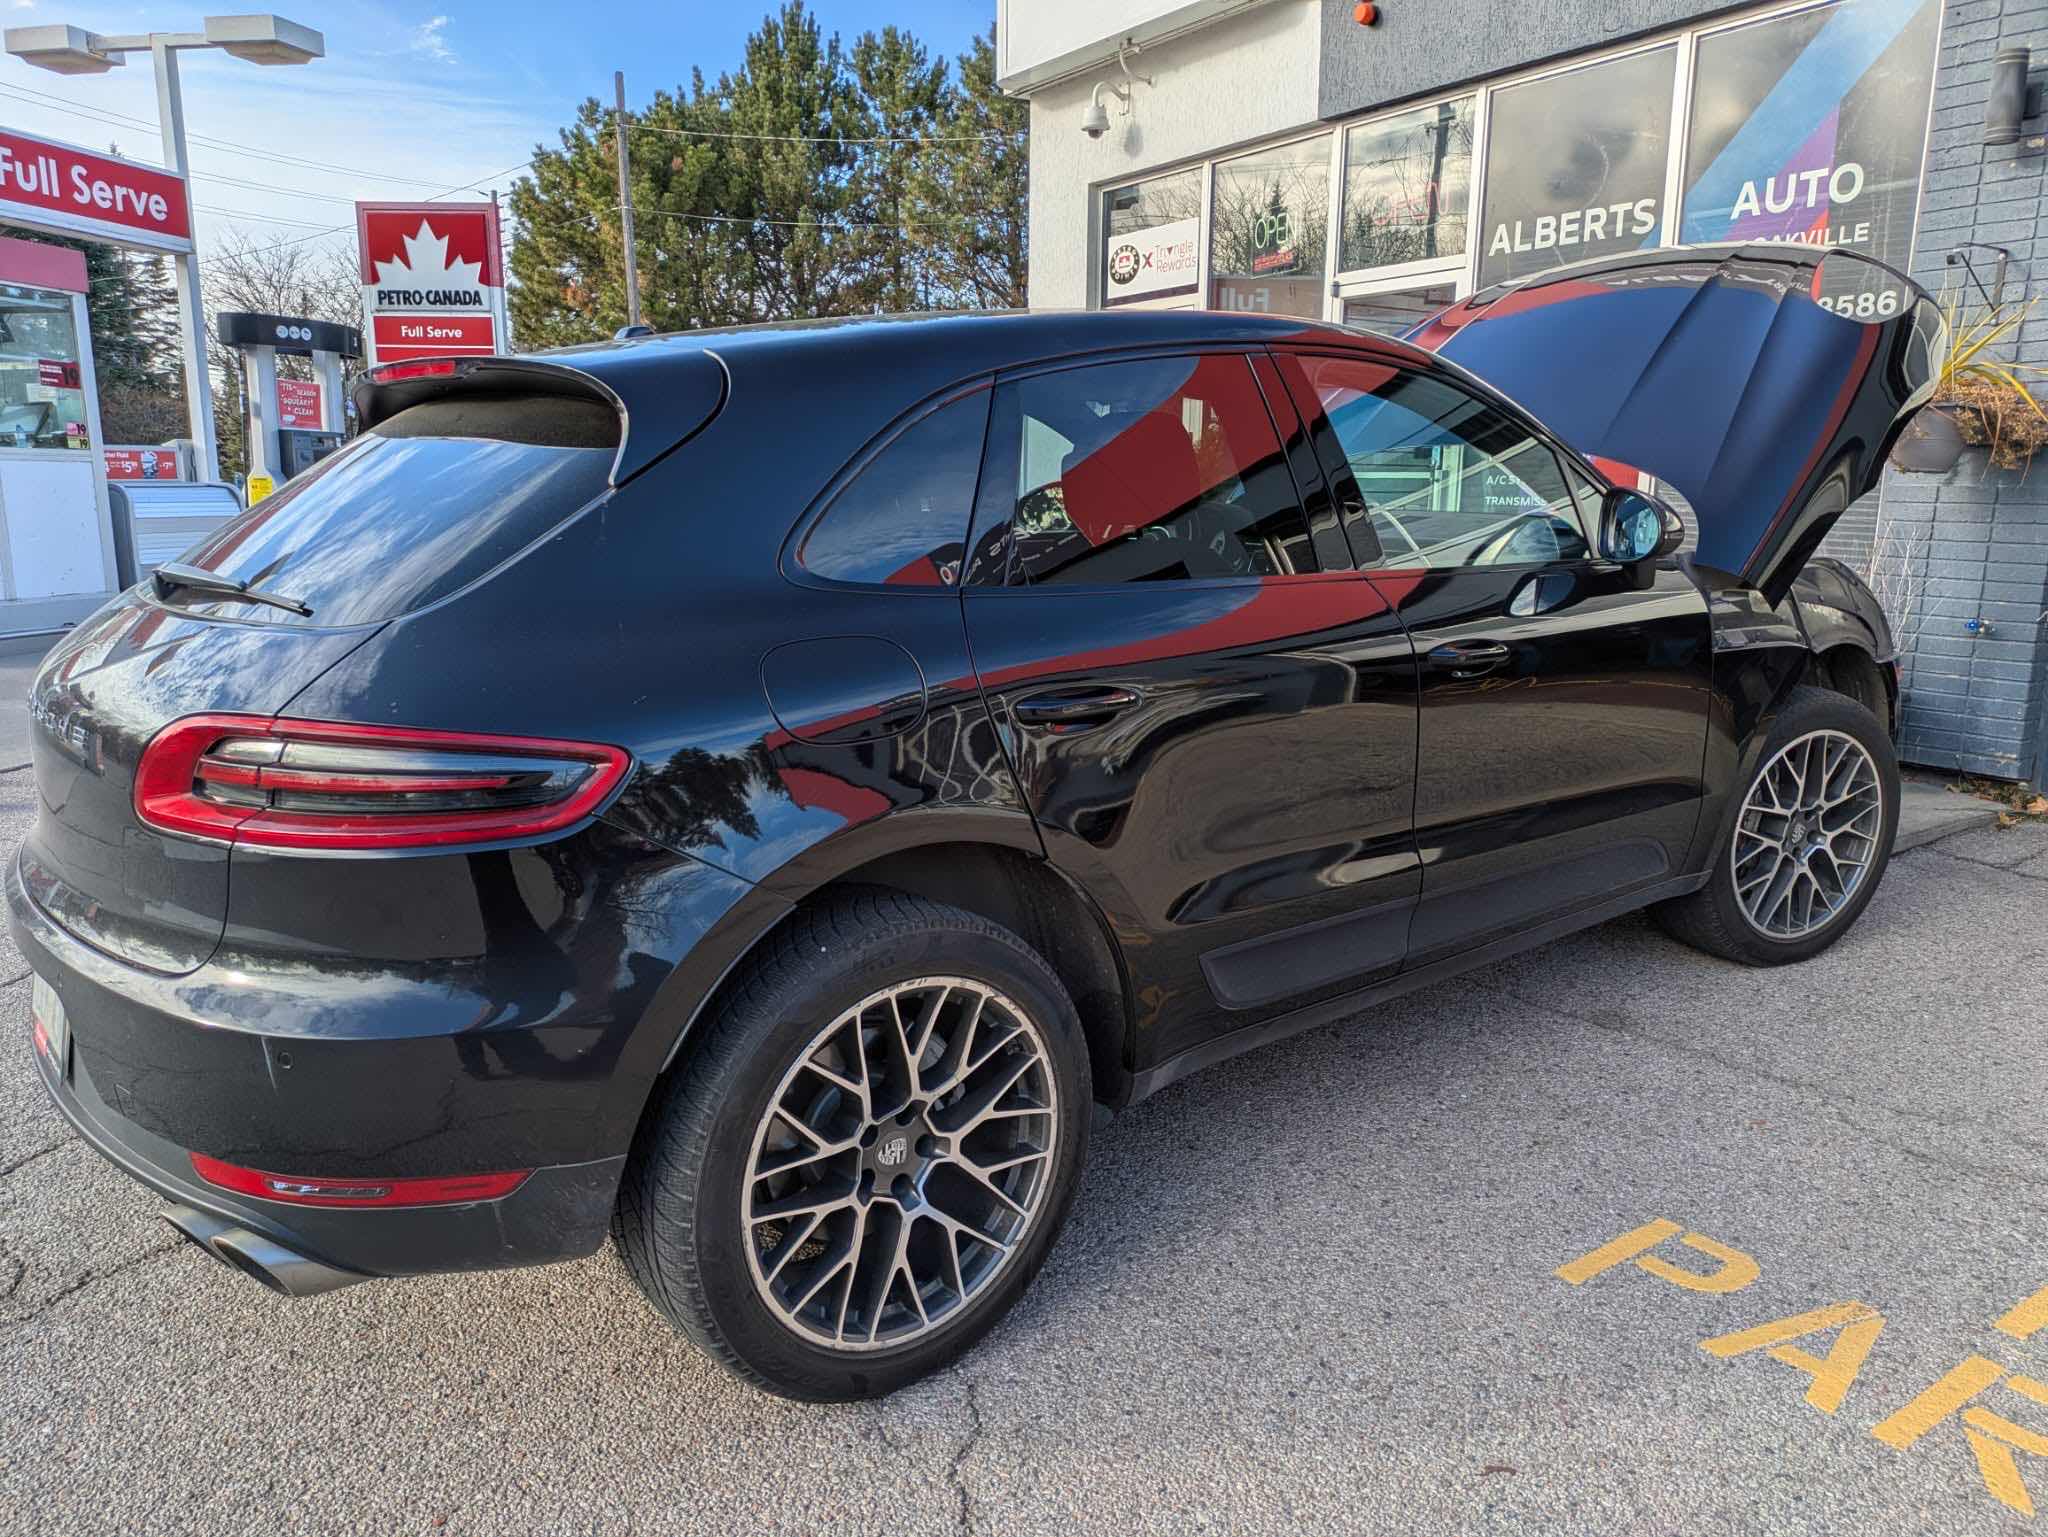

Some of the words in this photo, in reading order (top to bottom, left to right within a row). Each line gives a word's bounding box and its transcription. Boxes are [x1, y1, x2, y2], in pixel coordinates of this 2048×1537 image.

[0, 146, 61, 198] Full
[71, 165, 168, 221] Serve
[1730, 162, 1864, 220] AUTO
[1255, 211, 1297, 248] OPEN
[1488, 198, 1656, 257] ALBERTS
[1754, 222, 1870, 246] KVILLE
[1156, 254, 1196, 272] Rewards
[377, 289, 483, 306] PETRO-CANADA
[401, 325, 423, 338] Full
[427, 326, 463, 338] Serve
[76, 423, 87, 435] 19
[1486, 474, 1507, 485] A/C
